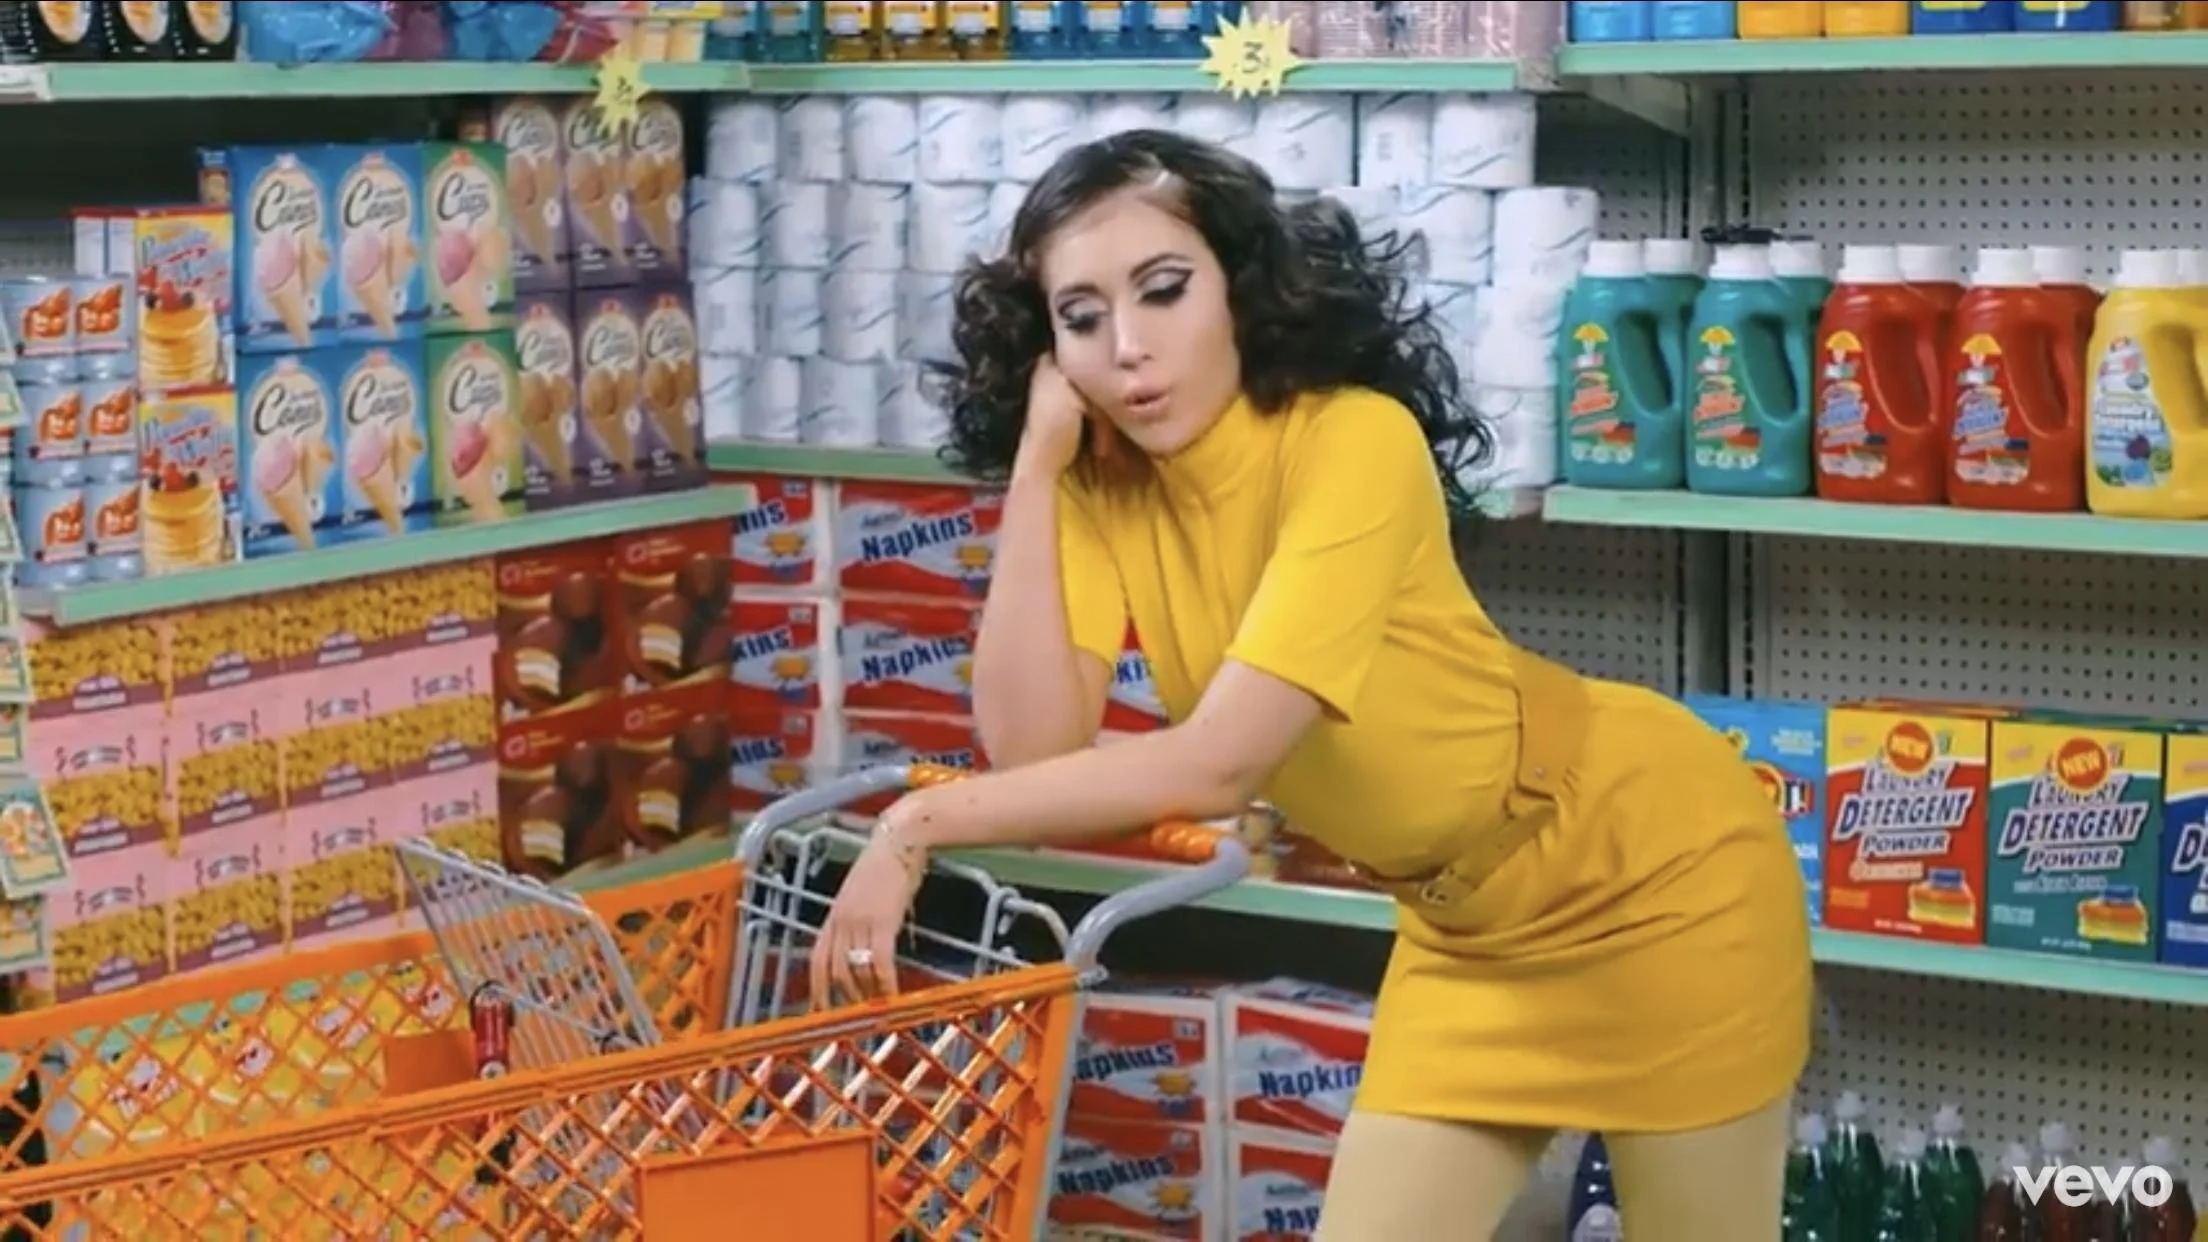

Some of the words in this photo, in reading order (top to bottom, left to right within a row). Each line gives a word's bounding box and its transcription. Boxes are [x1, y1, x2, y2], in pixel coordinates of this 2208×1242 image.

[861, 512, 973, 563] Napkins
[1891, 732, 1931, 764] NEW
[2060, 749, 2101, 781] NEW
[1839, 792, 1969, 835] DETERGENT
[2003, 806, 2143, 849] DETERGENT
[1863, 833, 1947, 852] POWDER
[2028, 849, 2120, 869] POWDER
[1073, 1042, 1174, 1081] apkins
[1056, 1155, 1174, 1194] Napkins
